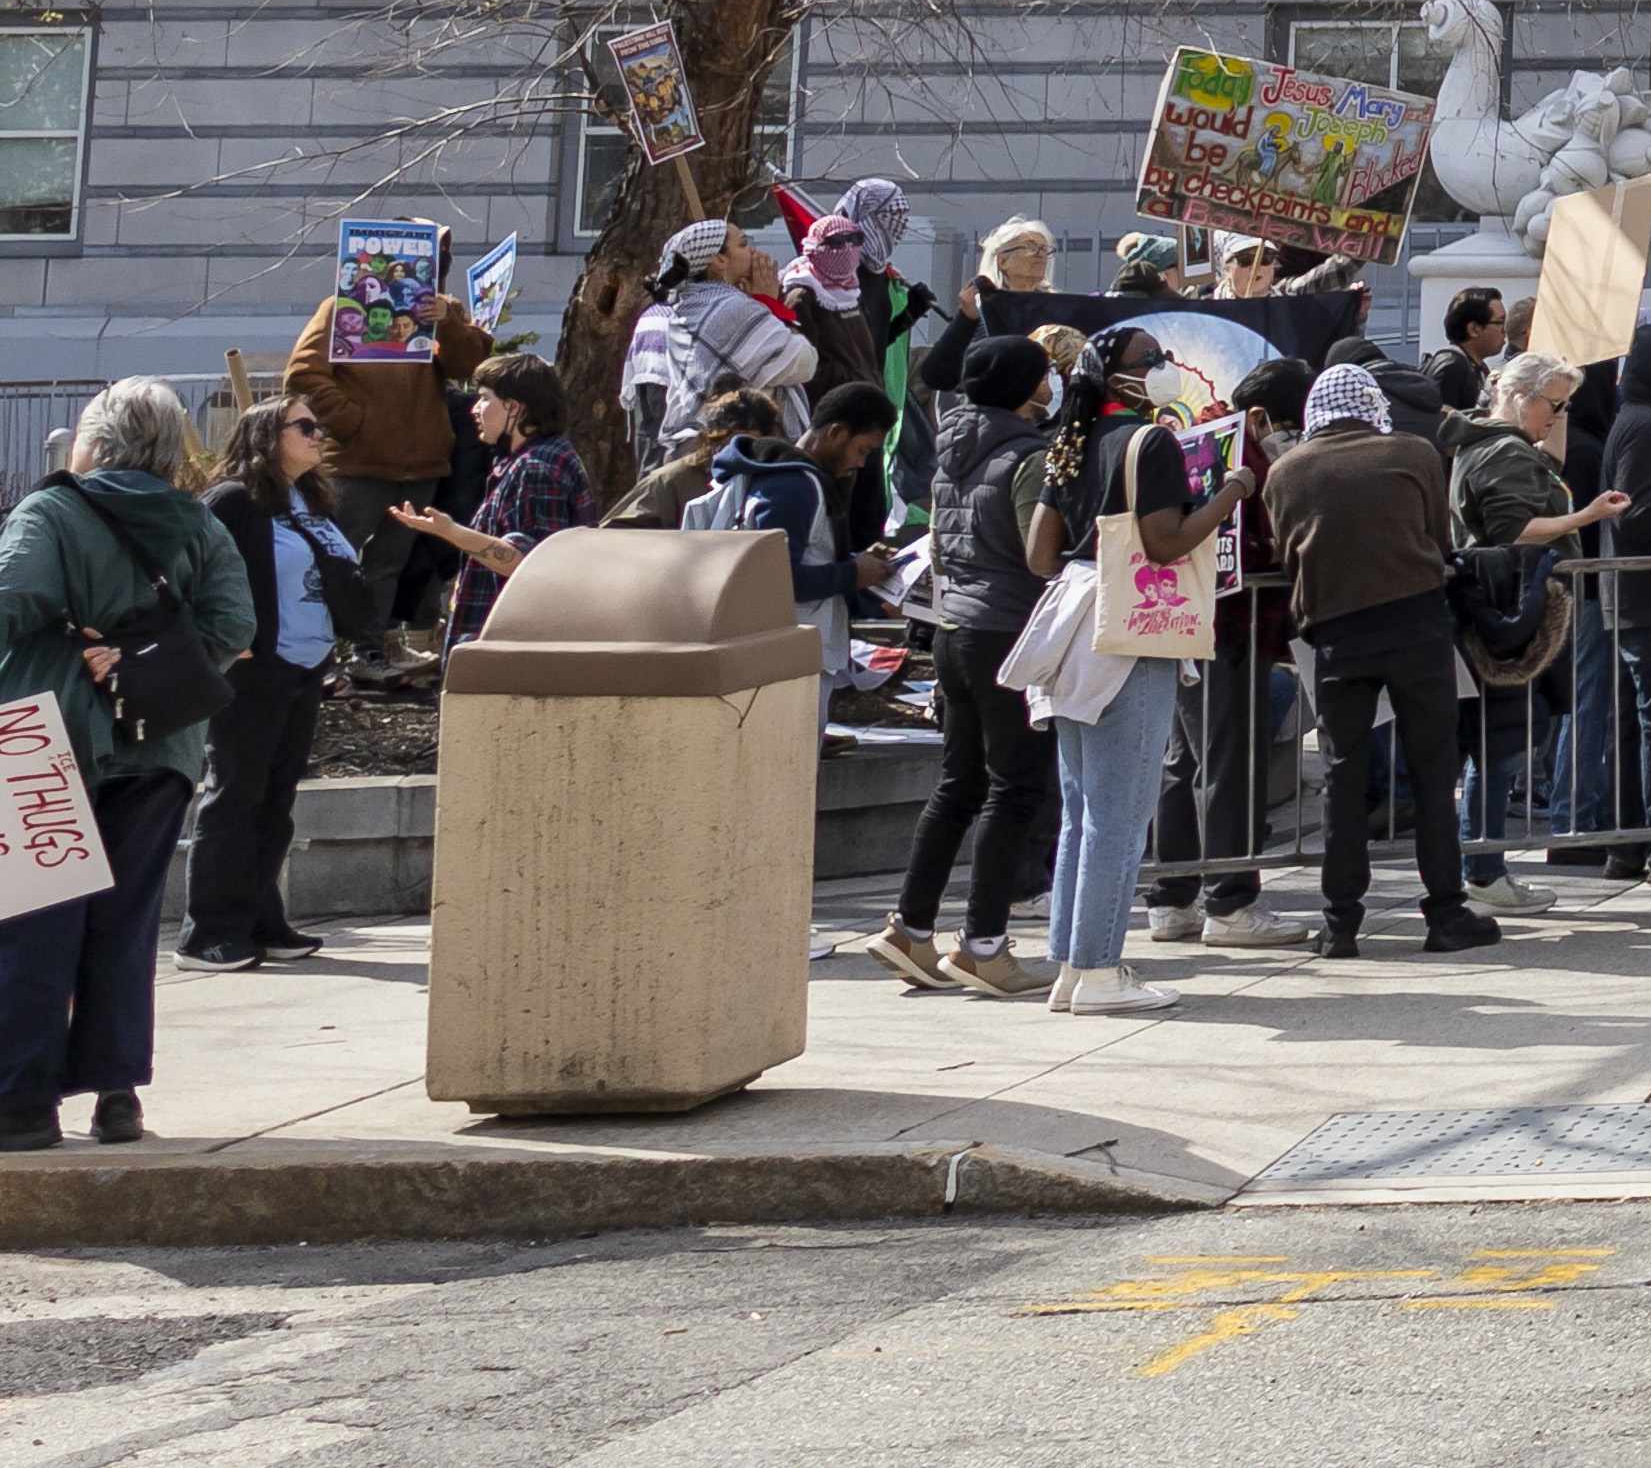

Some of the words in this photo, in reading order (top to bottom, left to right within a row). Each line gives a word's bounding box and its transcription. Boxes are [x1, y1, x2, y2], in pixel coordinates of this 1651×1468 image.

[1297, 106, 1388, 144] Joseph
[1336, 84, 1406, 128] Mary
[1185, 130, 1227, 167] be
[1143, 155, 1178, 196] by
[1184, 166, 1332, 227] checkpoints
[1345, 209, 1391, 237] and
[348, 236, 433, 257] POWER
[1147, 200, 1173, 217] a
[1312, 225, 1385, 260] Wall
[0, 704, 52, 756] NO
[57, 751, 76, 772] ICE
[6, 763, 90, 868] THUGS
